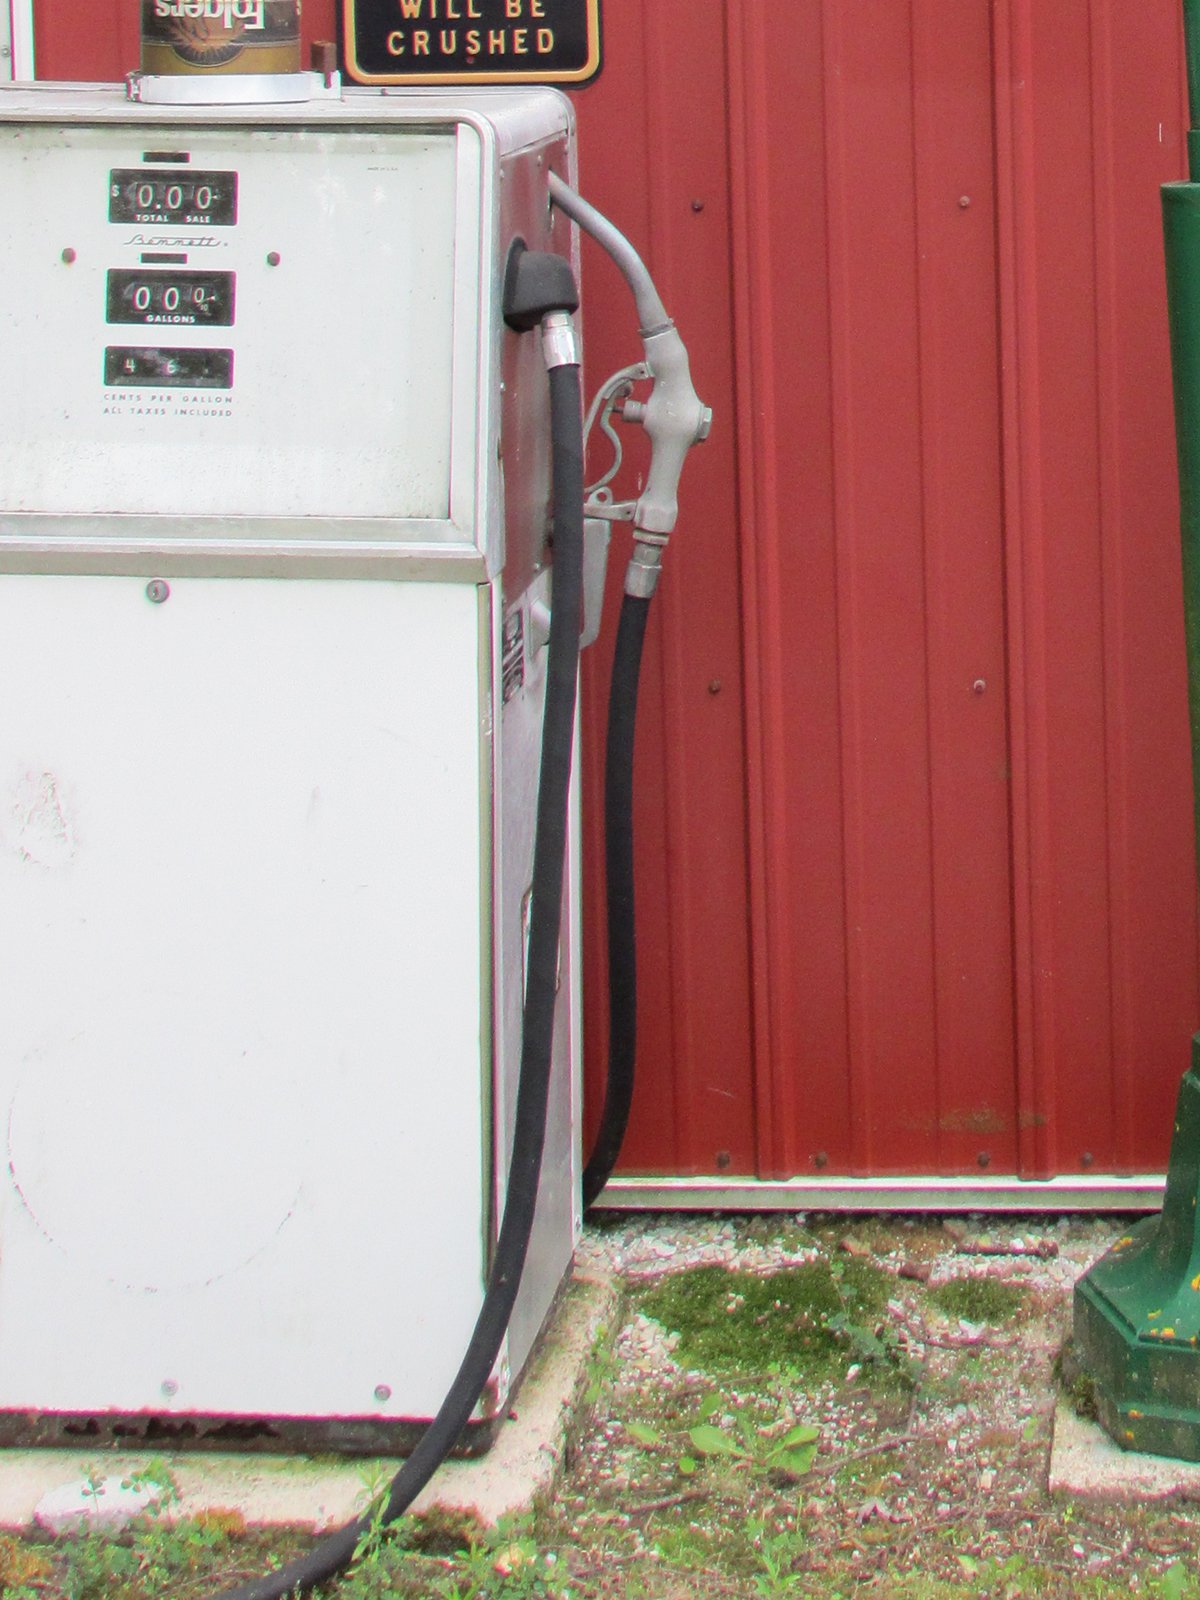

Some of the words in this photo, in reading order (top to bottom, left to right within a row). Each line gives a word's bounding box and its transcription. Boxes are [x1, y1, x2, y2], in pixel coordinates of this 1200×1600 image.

[387, 28, 555, 56] CRUSHED
[136, 214, 169, 223] TOTAL
[186, 215, 211, 223] SALE
[147, 315, 196, 324] GALLONS
[104, 394, 142, 402] CENTS
[183, 395, 233, 403] GALLON
[104, 407, 123, 415] ALL
[130, 407, 166, 416] TAXES
[175, 408, 233, 417] INCLUDED
